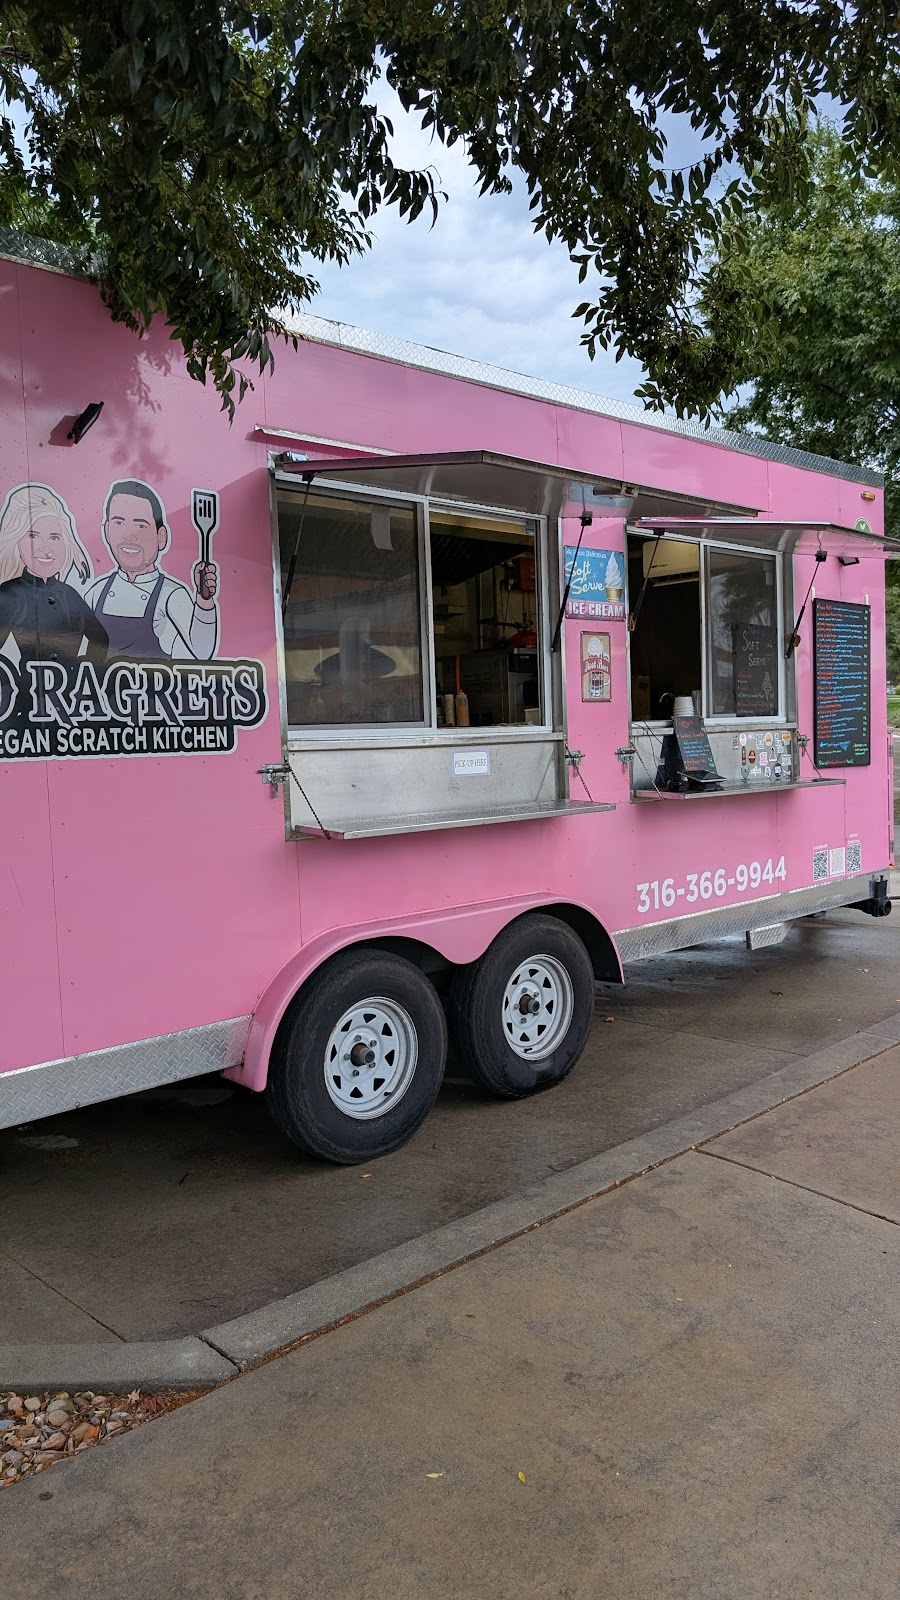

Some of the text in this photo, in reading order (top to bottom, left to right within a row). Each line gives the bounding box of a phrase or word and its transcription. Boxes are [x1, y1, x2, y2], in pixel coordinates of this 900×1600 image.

[565, 561, 592, 581] Soft
[570, 578, 605, 595] Serve
[568, 602, 624, 617] ICE CREAM
[26, 661, 260, 728] RAGRETS
[57, 727, 147, 753] SCRATCH
[153, 726, 228, 749] KITCHEN
[455, 759, 487, 768] PICK-UP HERE
[636, 856, 787, 913] 316-366-9944
